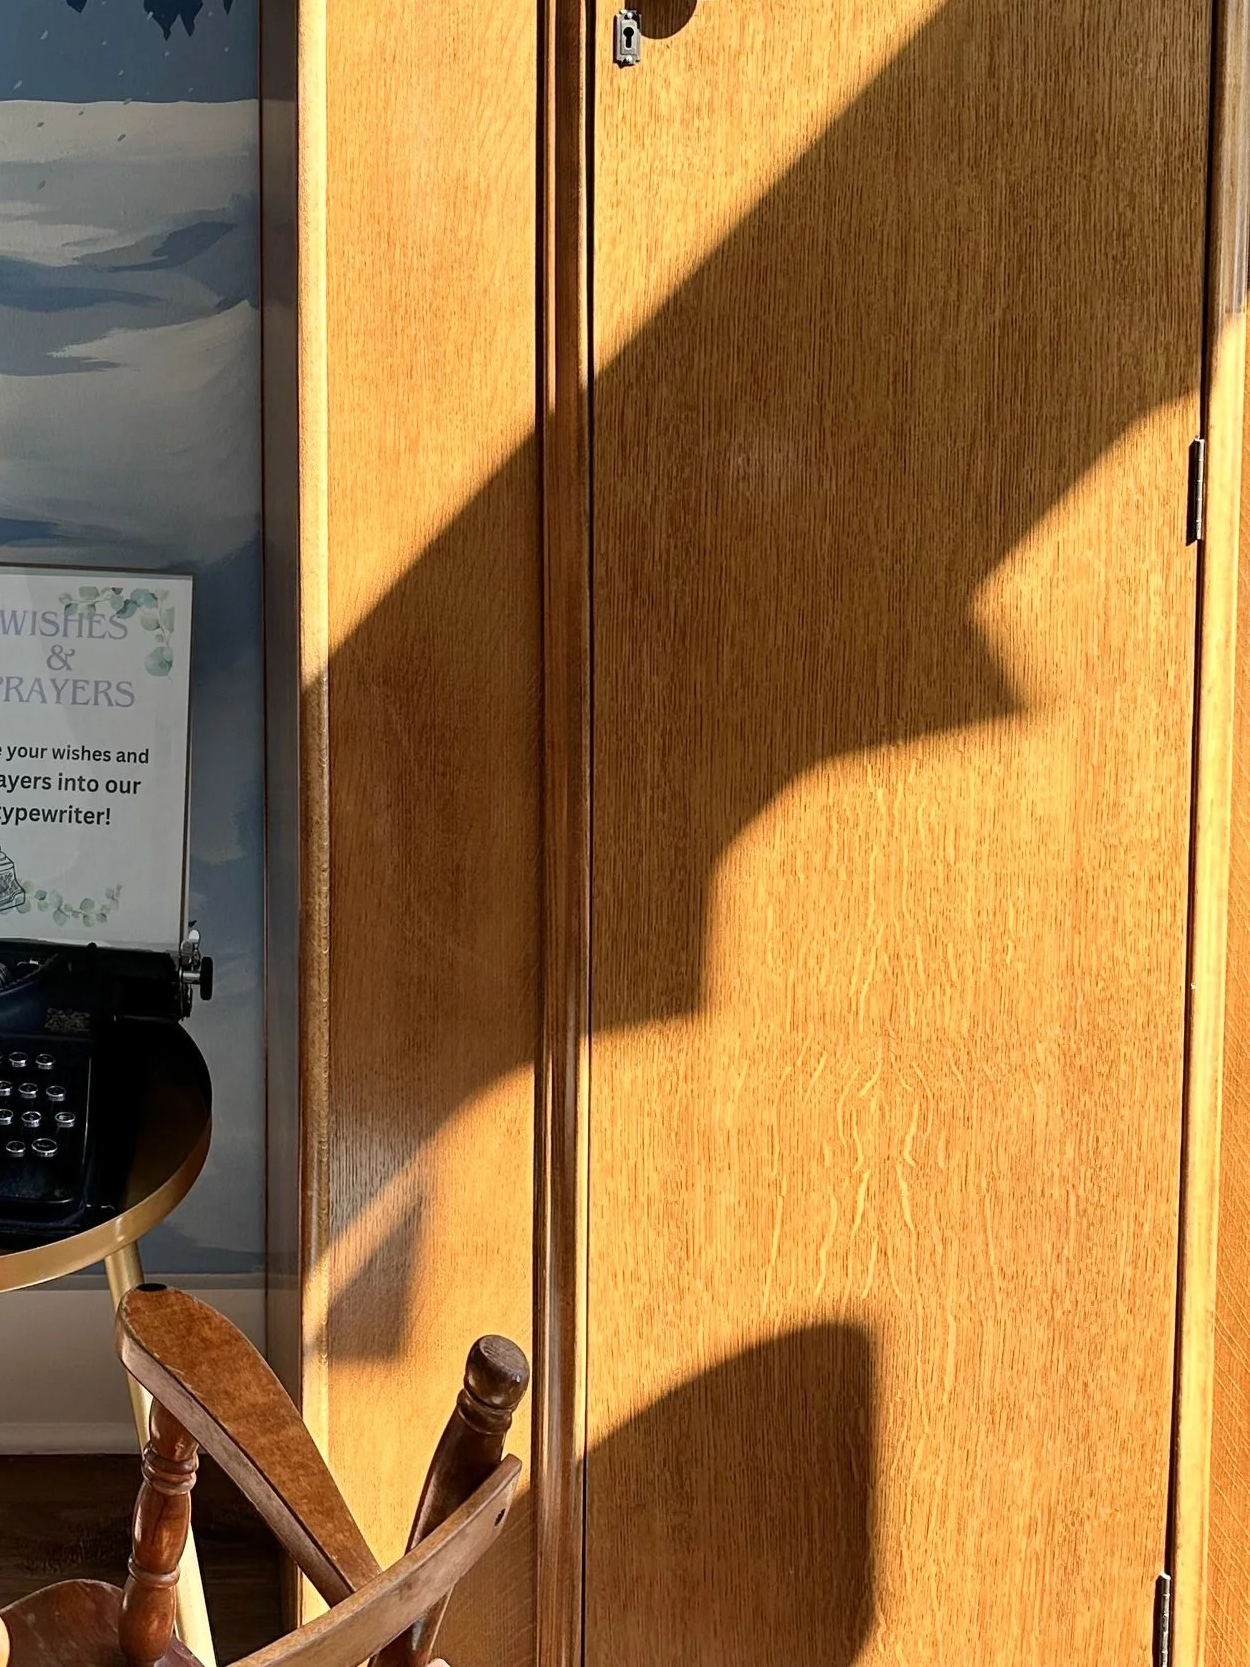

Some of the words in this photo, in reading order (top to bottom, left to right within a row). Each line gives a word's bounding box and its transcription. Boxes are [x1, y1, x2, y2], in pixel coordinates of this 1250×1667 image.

[0, 610, 128, 640] WISHES
[46, 644, 76, 671] &
[6, 745, 48, 761] your
[52, 744, 111, 762] wishes
[116, 748, 149, 764] and
[58, 772, 99, 792] into
[105, 778, 141, 794] our
